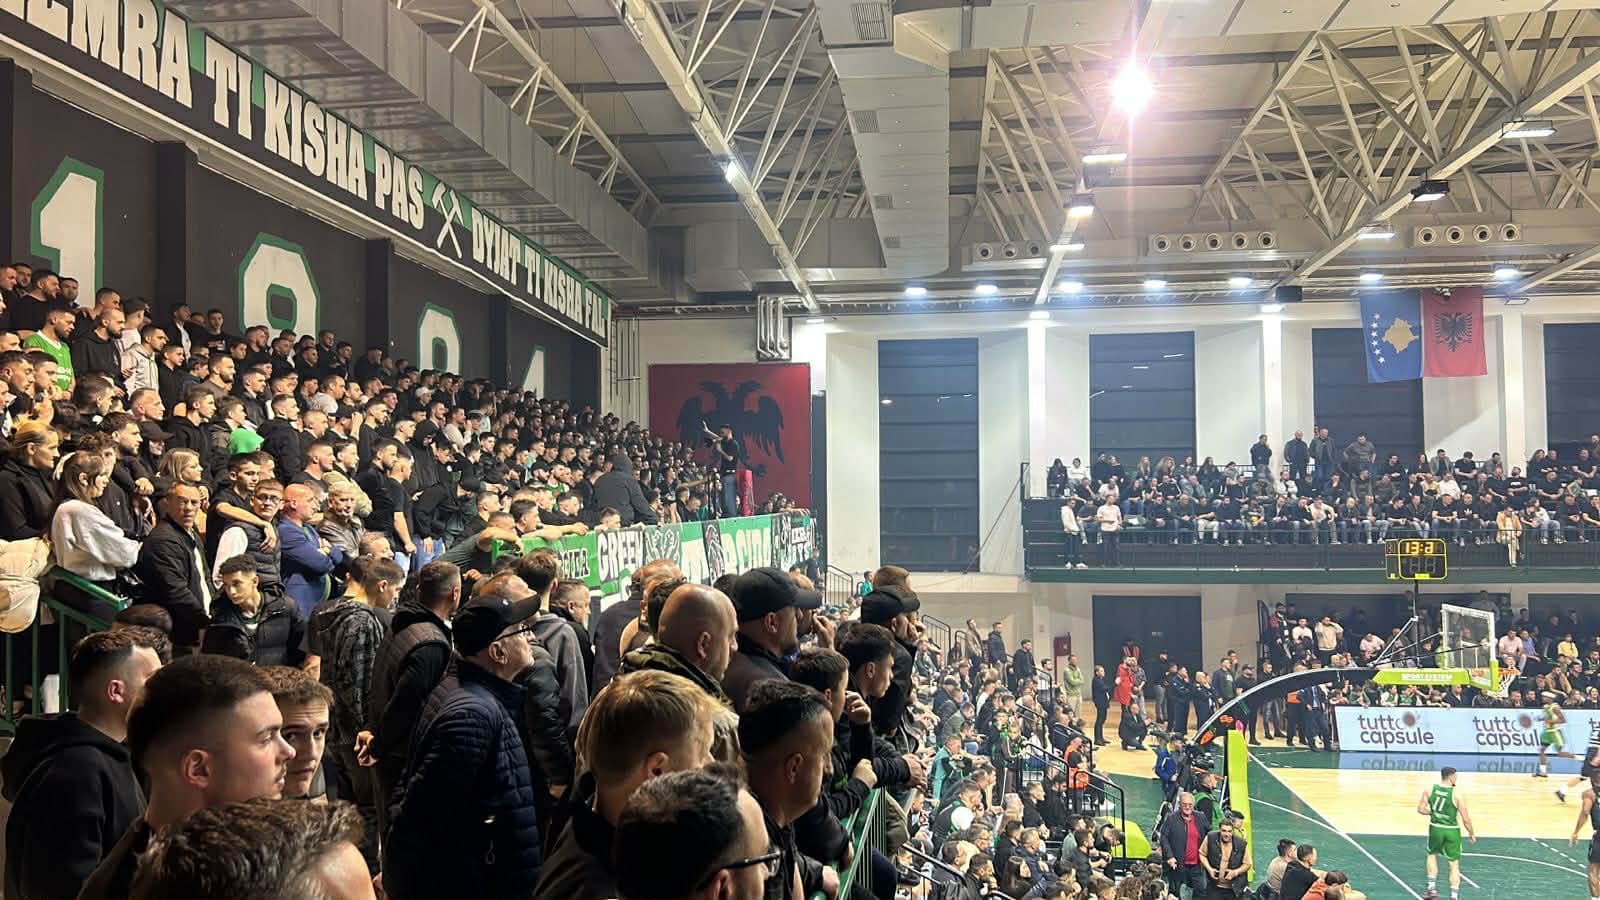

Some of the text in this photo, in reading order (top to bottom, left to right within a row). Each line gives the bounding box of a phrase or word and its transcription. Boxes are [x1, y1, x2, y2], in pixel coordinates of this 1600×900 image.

[205, 35, 252, 141] TI
[264, 71, 368, 200] KISHA
[374, 142, 425, 230] PAS
[524, 244, 541, 299] TI
[543, 257, 584, 326] KISHA
[598, 528, 644, 583] GREEN
[1360, 727, 1435, 749] capsule
[1475, 729, 1542, 750] capsul
[1432, 796, 1446, 812] 11
